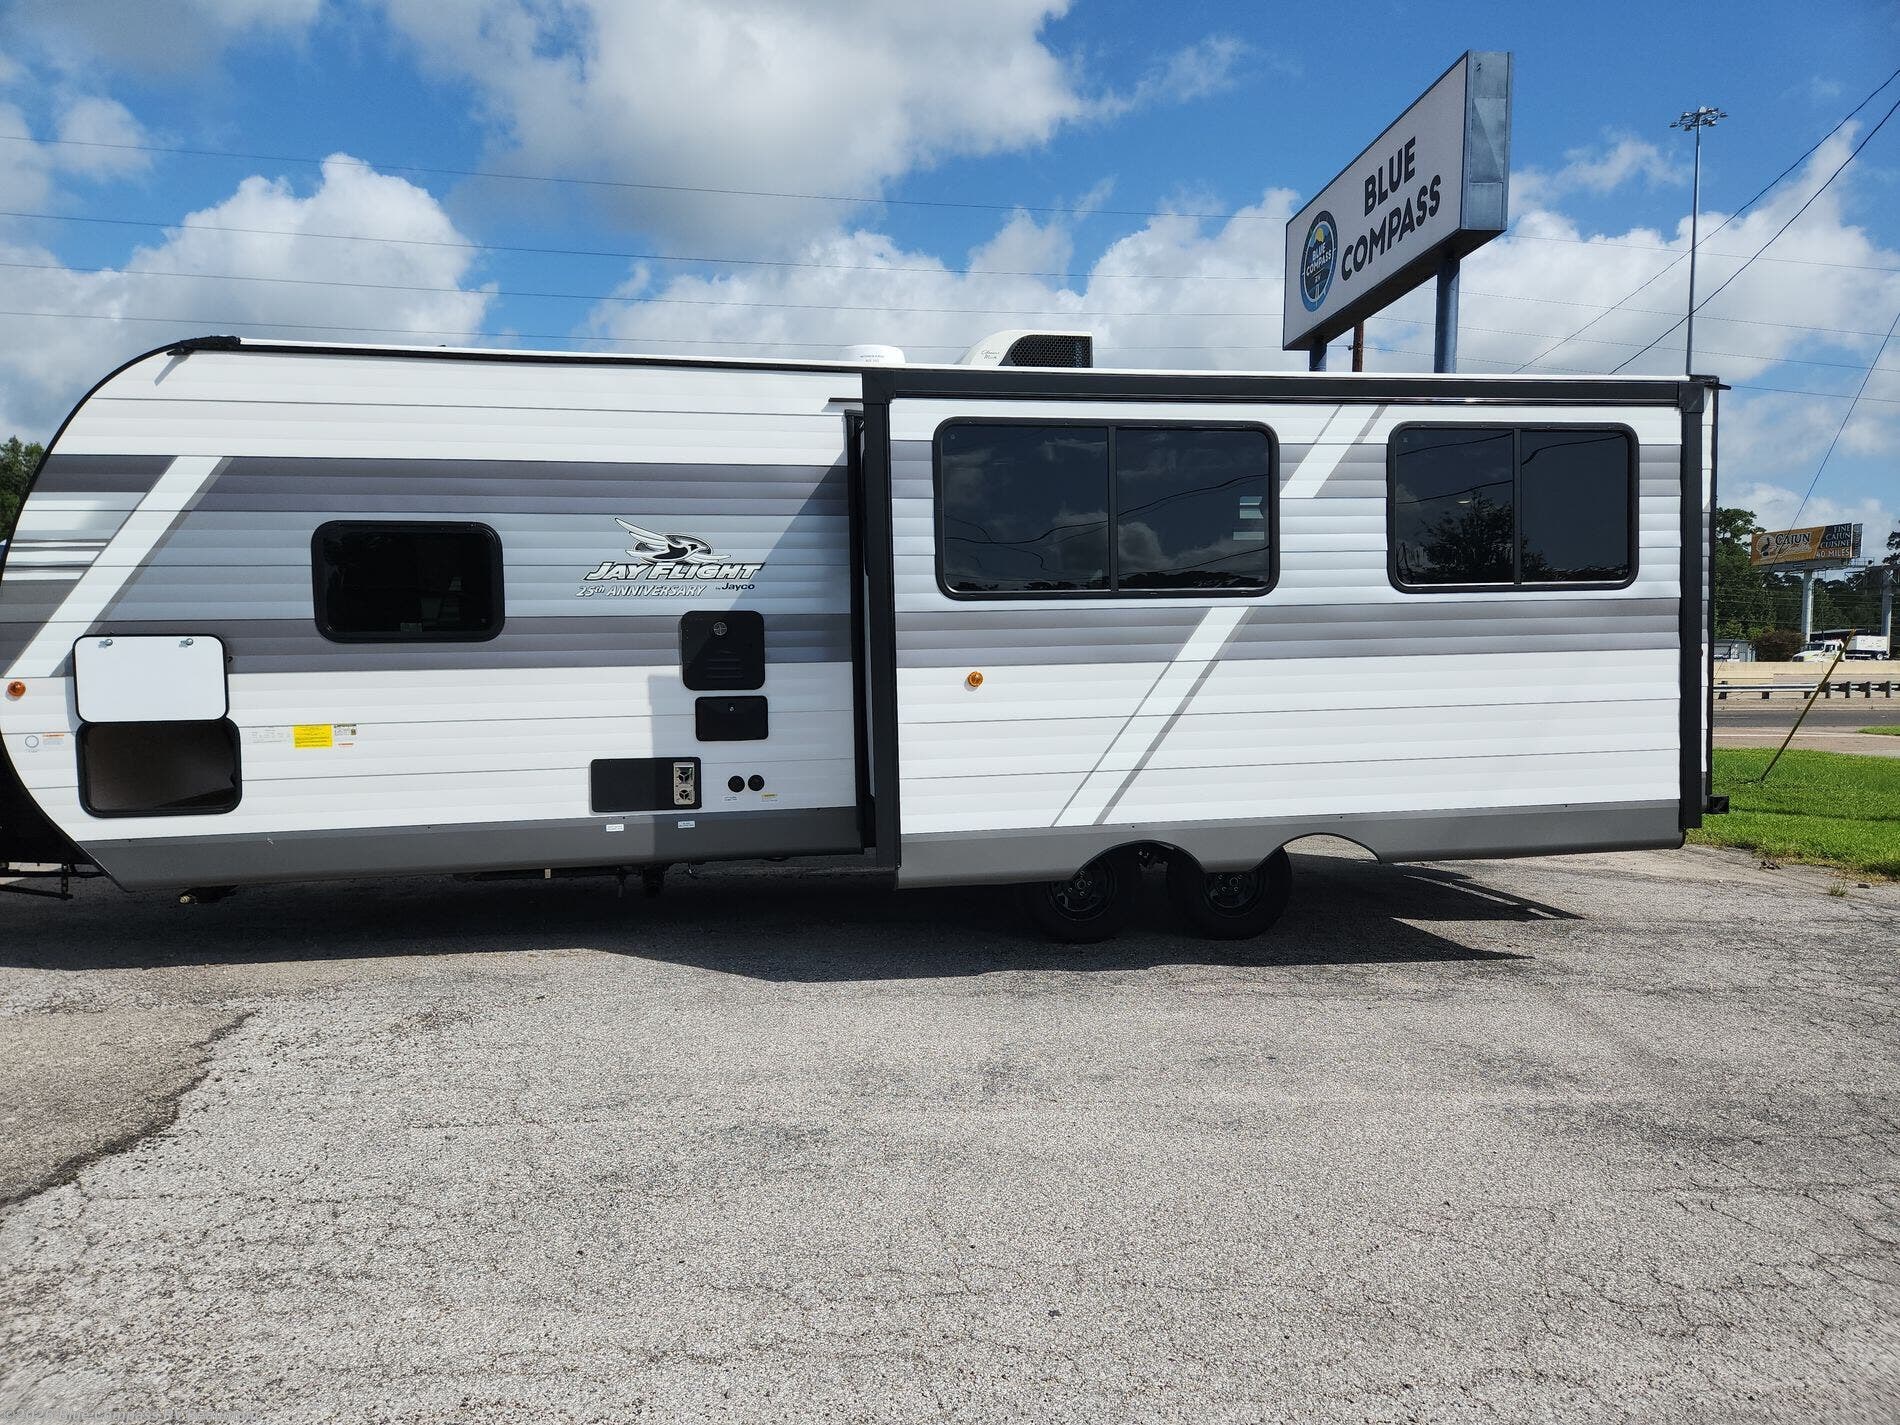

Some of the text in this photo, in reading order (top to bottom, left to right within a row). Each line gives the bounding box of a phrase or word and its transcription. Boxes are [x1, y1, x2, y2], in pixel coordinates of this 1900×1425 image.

[1364, 136, 1416, 217] BLUE
[1341, 174, 1441, 281] COMPASS
[1312, 242, 1326, 261] BLUE
[1306, 250, 1332, 276] COMPASS
[1834, 525, 1851, 533] FINE
[1775, 533, 1810, 545] CAJUN
[1820, 540, 1850, 548] CUISINE
[1828, 548, 1849, 557] MILES
[583, 562, 766, 581] JAY FLIGHT
[576, 584, 708, 597] 25th ANNIVERSARY
[721, 582, 755, 592] Jayco
